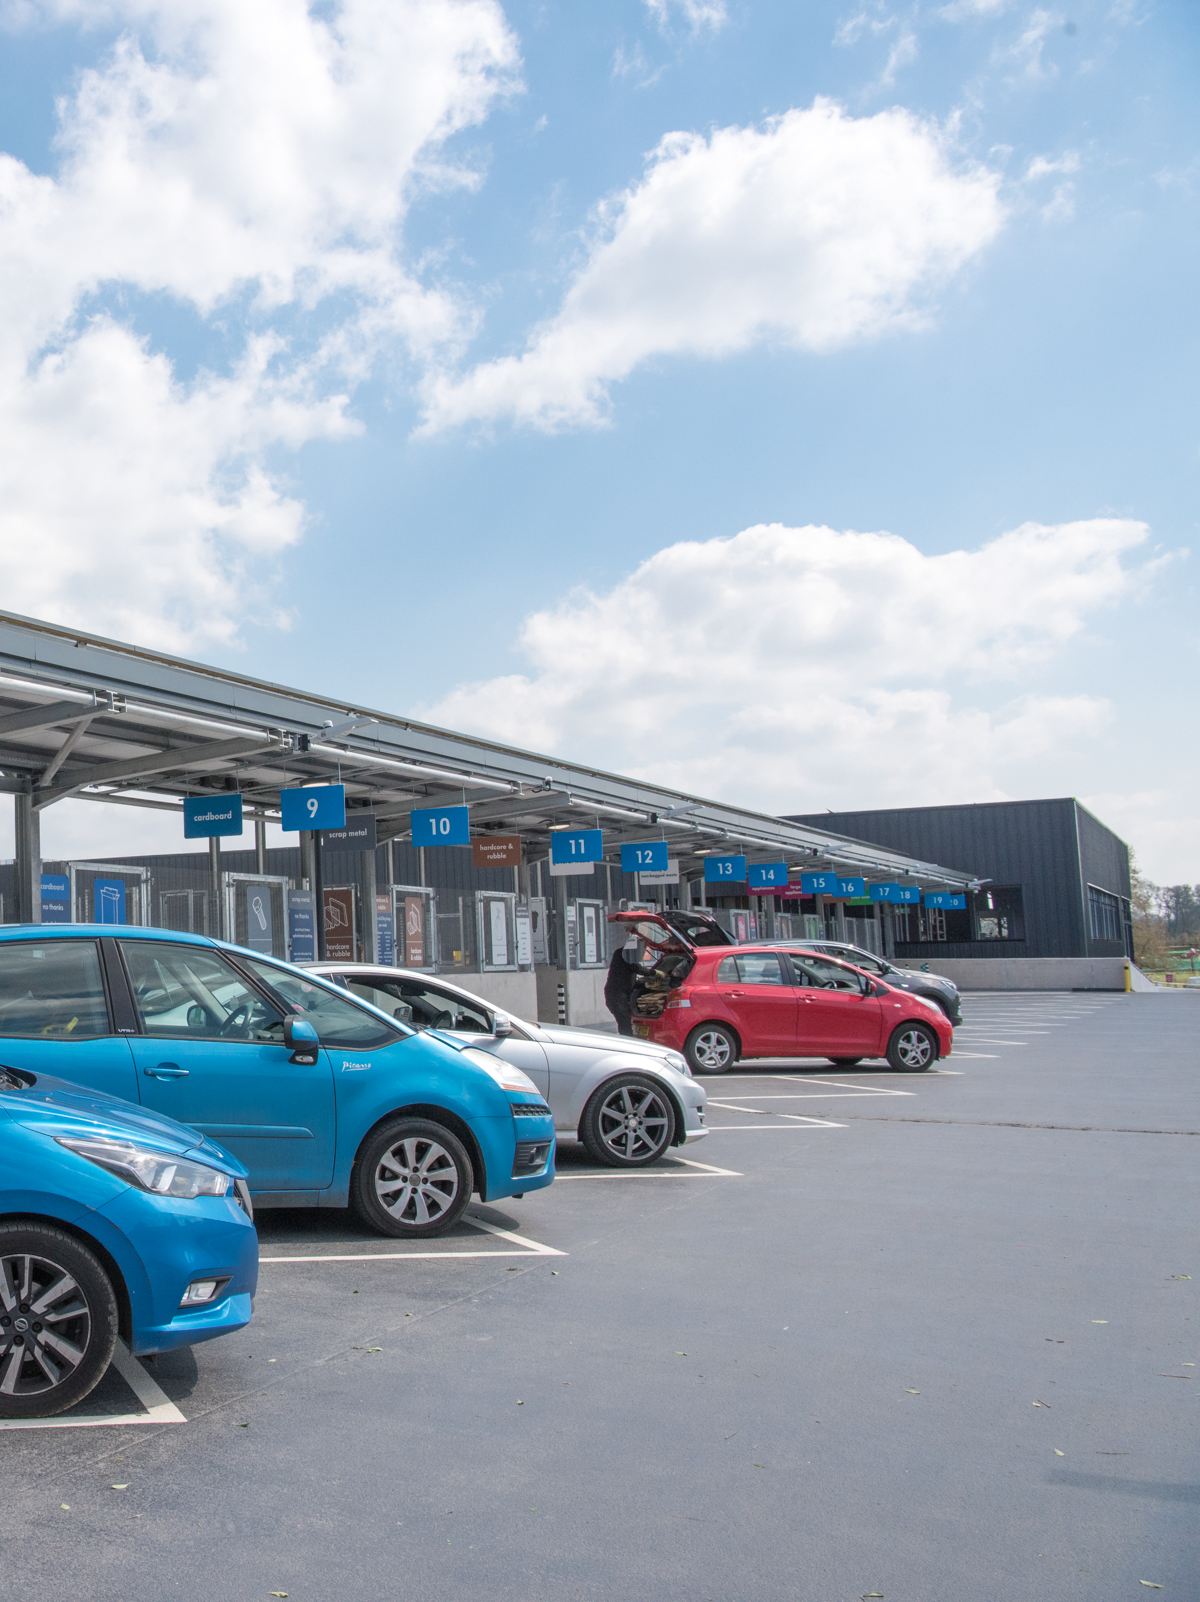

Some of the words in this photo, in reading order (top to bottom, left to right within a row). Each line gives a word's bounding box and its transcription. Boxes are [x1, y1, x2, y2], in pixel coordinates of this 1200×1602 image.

[306, 798, 319, 818] 9
[193, 810, 232, 822] cardboard
[429, 817, 450, 836] 10
[328, 831, 347, 839] scrap
[348, 828, 367, 837] metal
[569, 839, 585, 855] 11
[636, 850, 653, 864] 12
[717, 862, 733, 875] 13
[761, 869, 775, 880] 14
[812, 878, 826, 888] 15
[841, 882, 855, 892] 16
[878, 887, 890, 896] 17
[900, 890, 911, 900] 18
[932, 896, 943, 904] 19
[49, 903, 64, 911] thanks
[341, 1061, 372, 1073] Picasso
